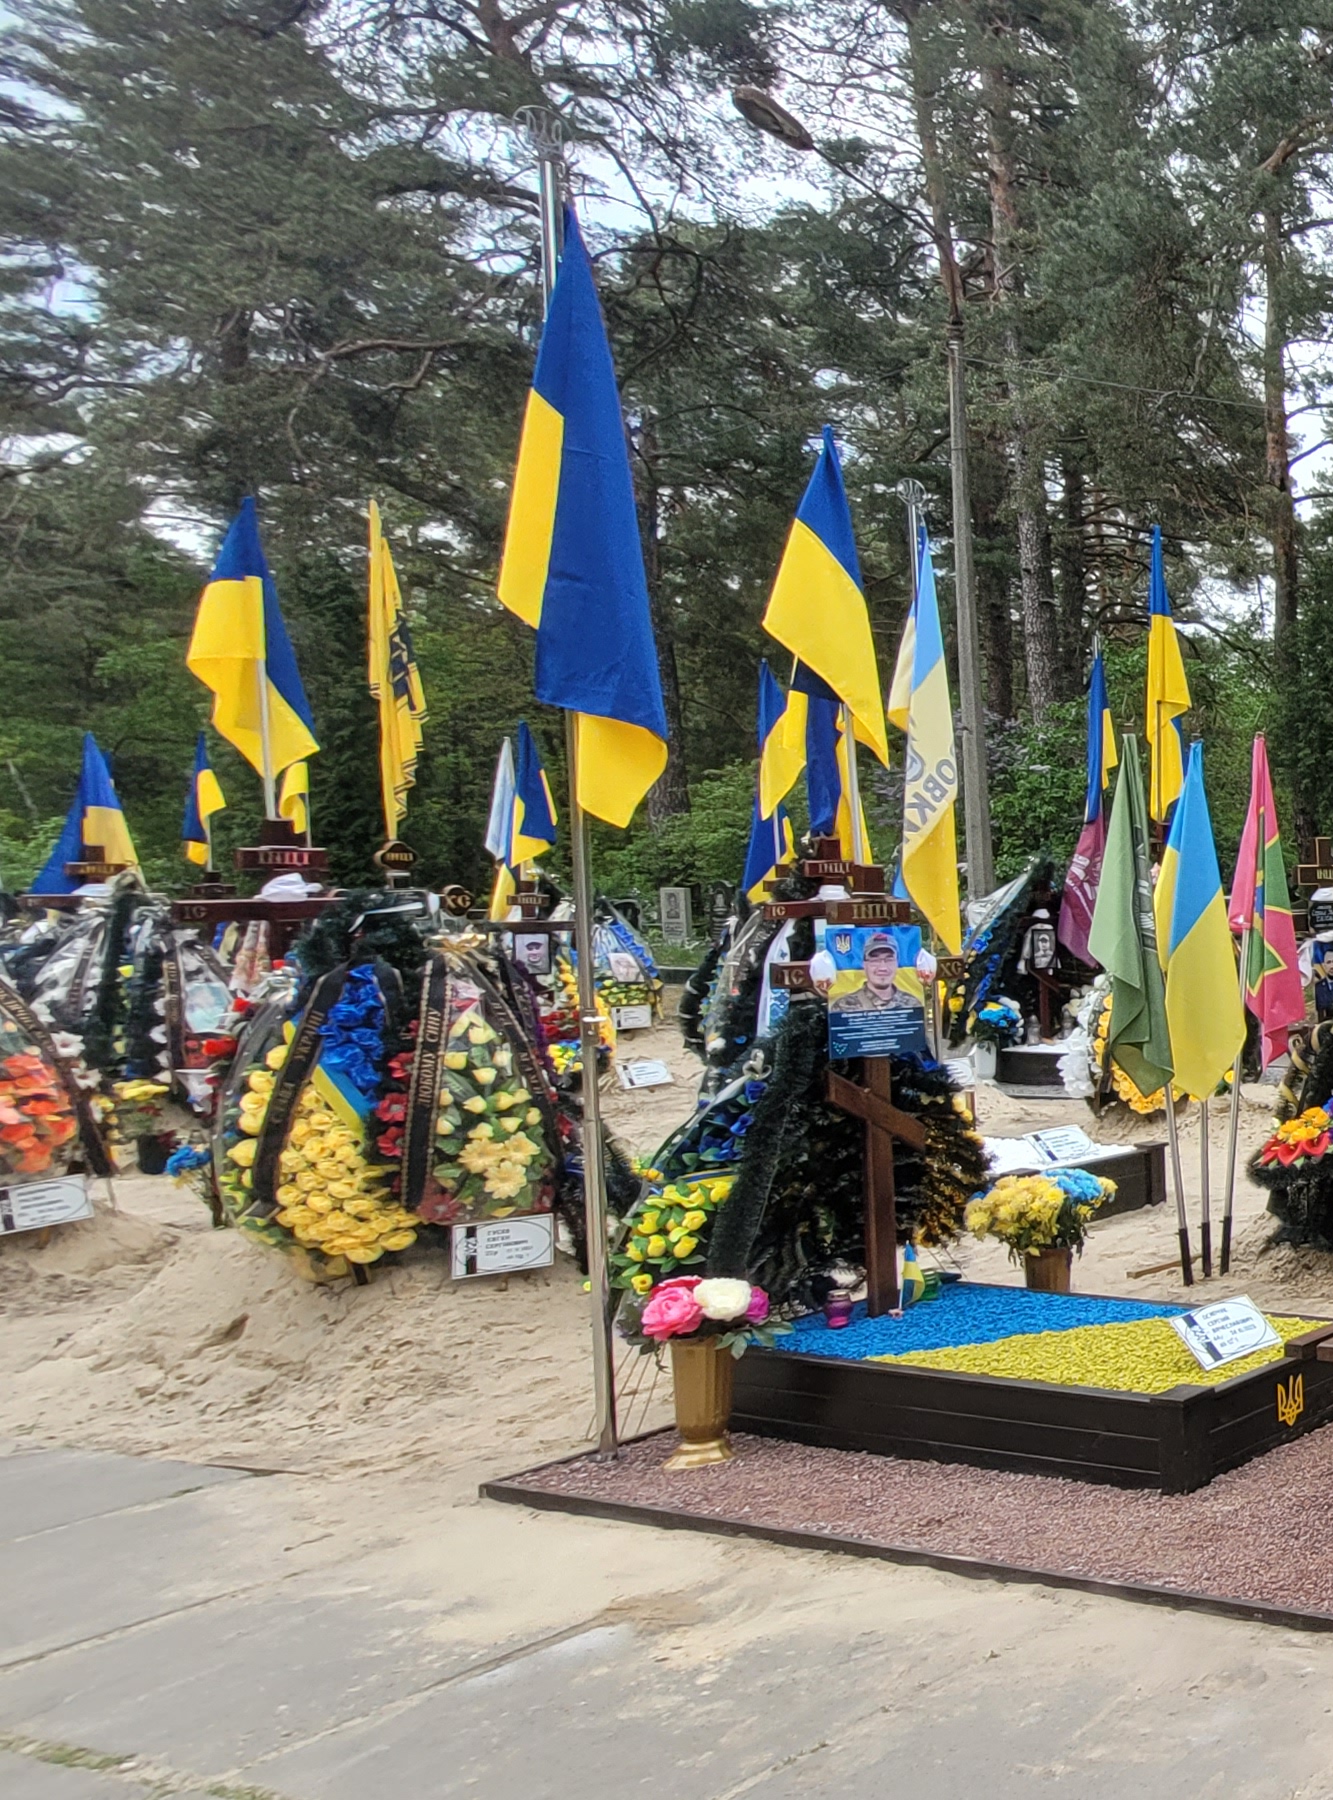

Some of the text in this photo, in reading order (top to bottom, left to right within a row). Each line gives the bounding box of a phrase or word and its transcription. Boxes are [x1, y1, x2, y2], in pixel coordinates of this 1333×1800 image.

[852, 902, 898, 920] ІНЦІ
[783, 961, 963, 985] ІС ХС
[417, 1007, 442, 1106] ЛЮБОМУ СИНУ
